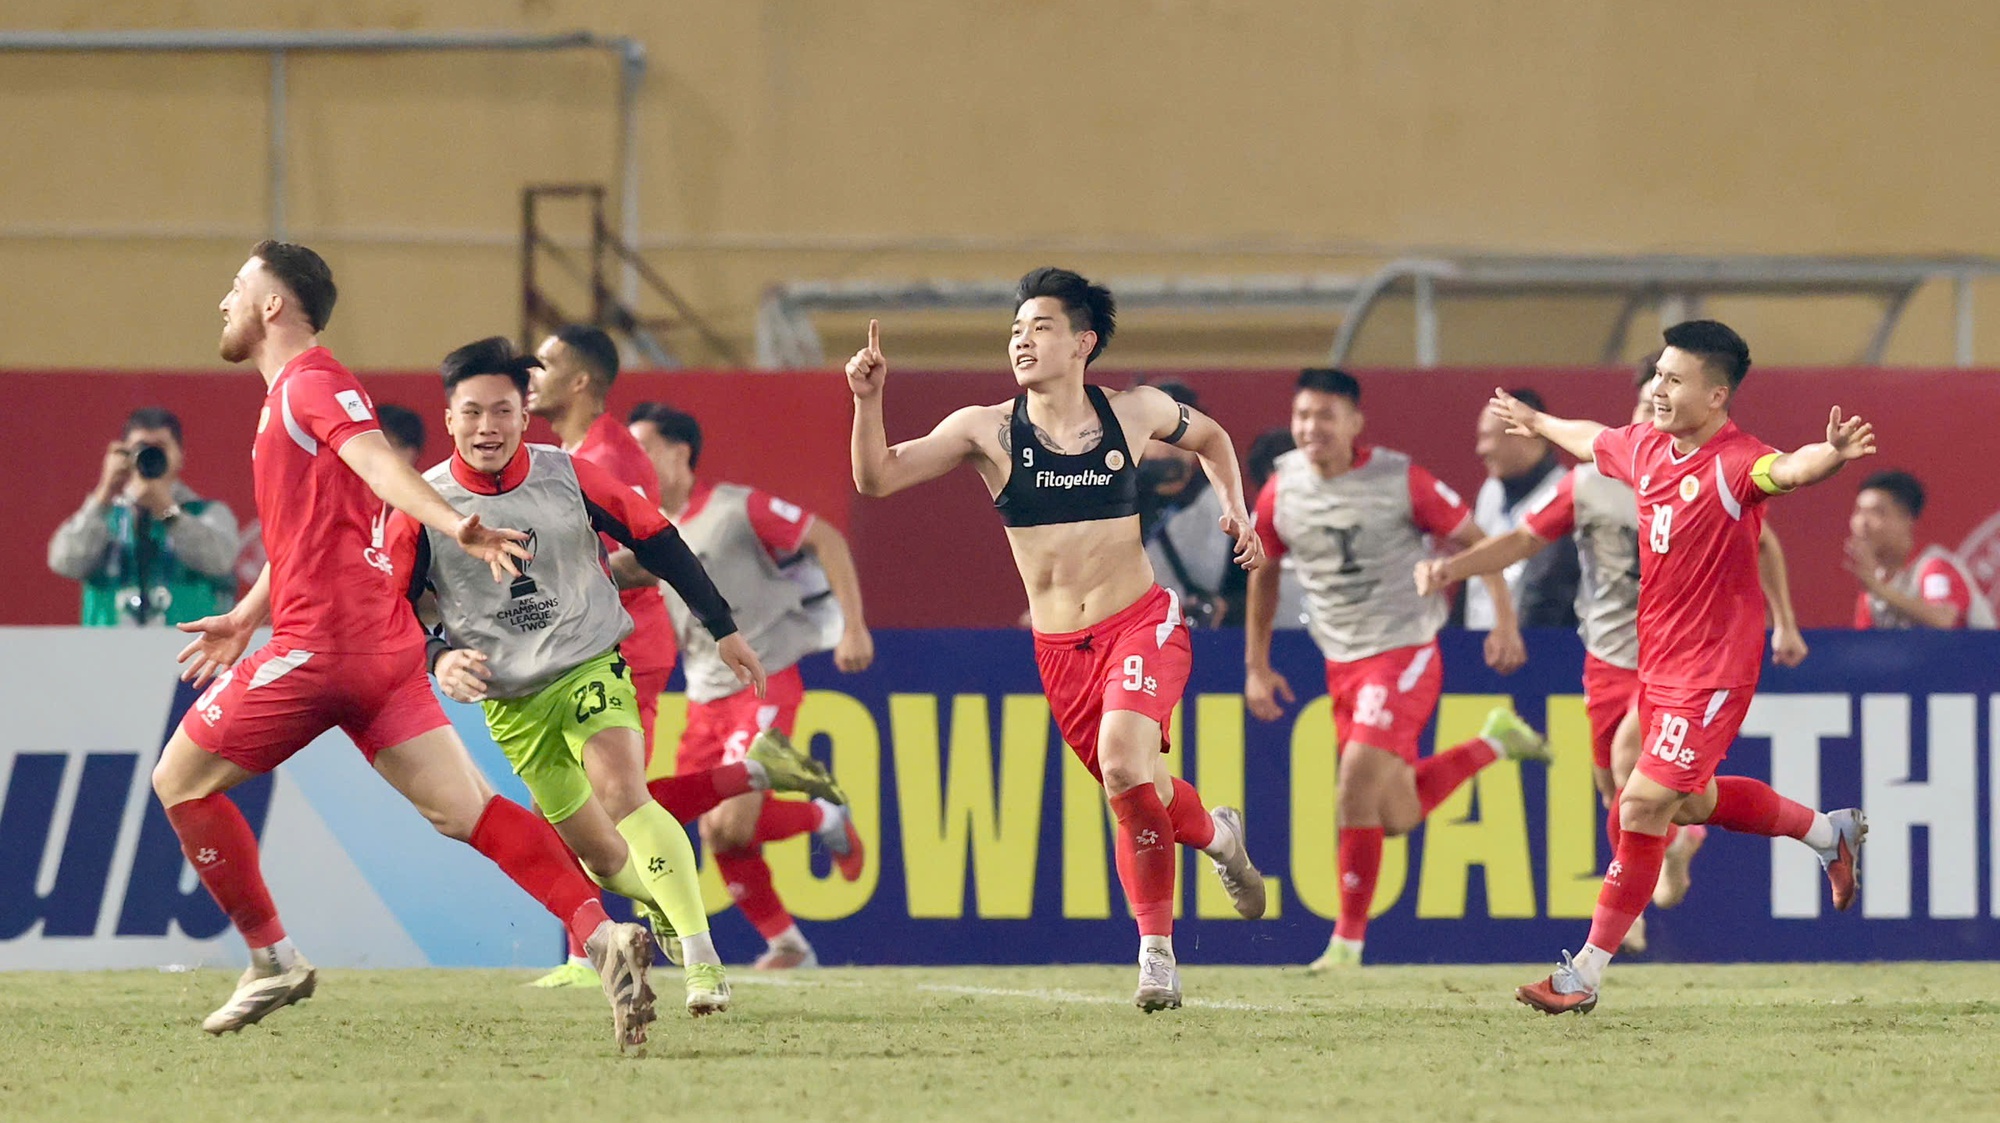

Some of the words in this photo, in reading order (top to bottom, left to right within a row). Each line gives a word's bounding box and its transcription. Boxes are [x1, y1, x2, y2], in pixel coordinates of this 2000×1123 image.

[1022, 447, 1034, 468] 9
[1036, 469, 1113, 490] Fitogether
[1650, 503, 1673, 554] 19
[496, 597, 559, 620] CHAMPIONS
[519, 597, 535, 606] AFC
[510, 610, 552, 626] LEAGUE
[520, 621, 547, 633] TWO
[1122, 654, 1143, 691] 9
[574, 681, 607, 724] 23
[1651, 713, 1690, 763] 19
[1738, 692, 2000, 920] TH
